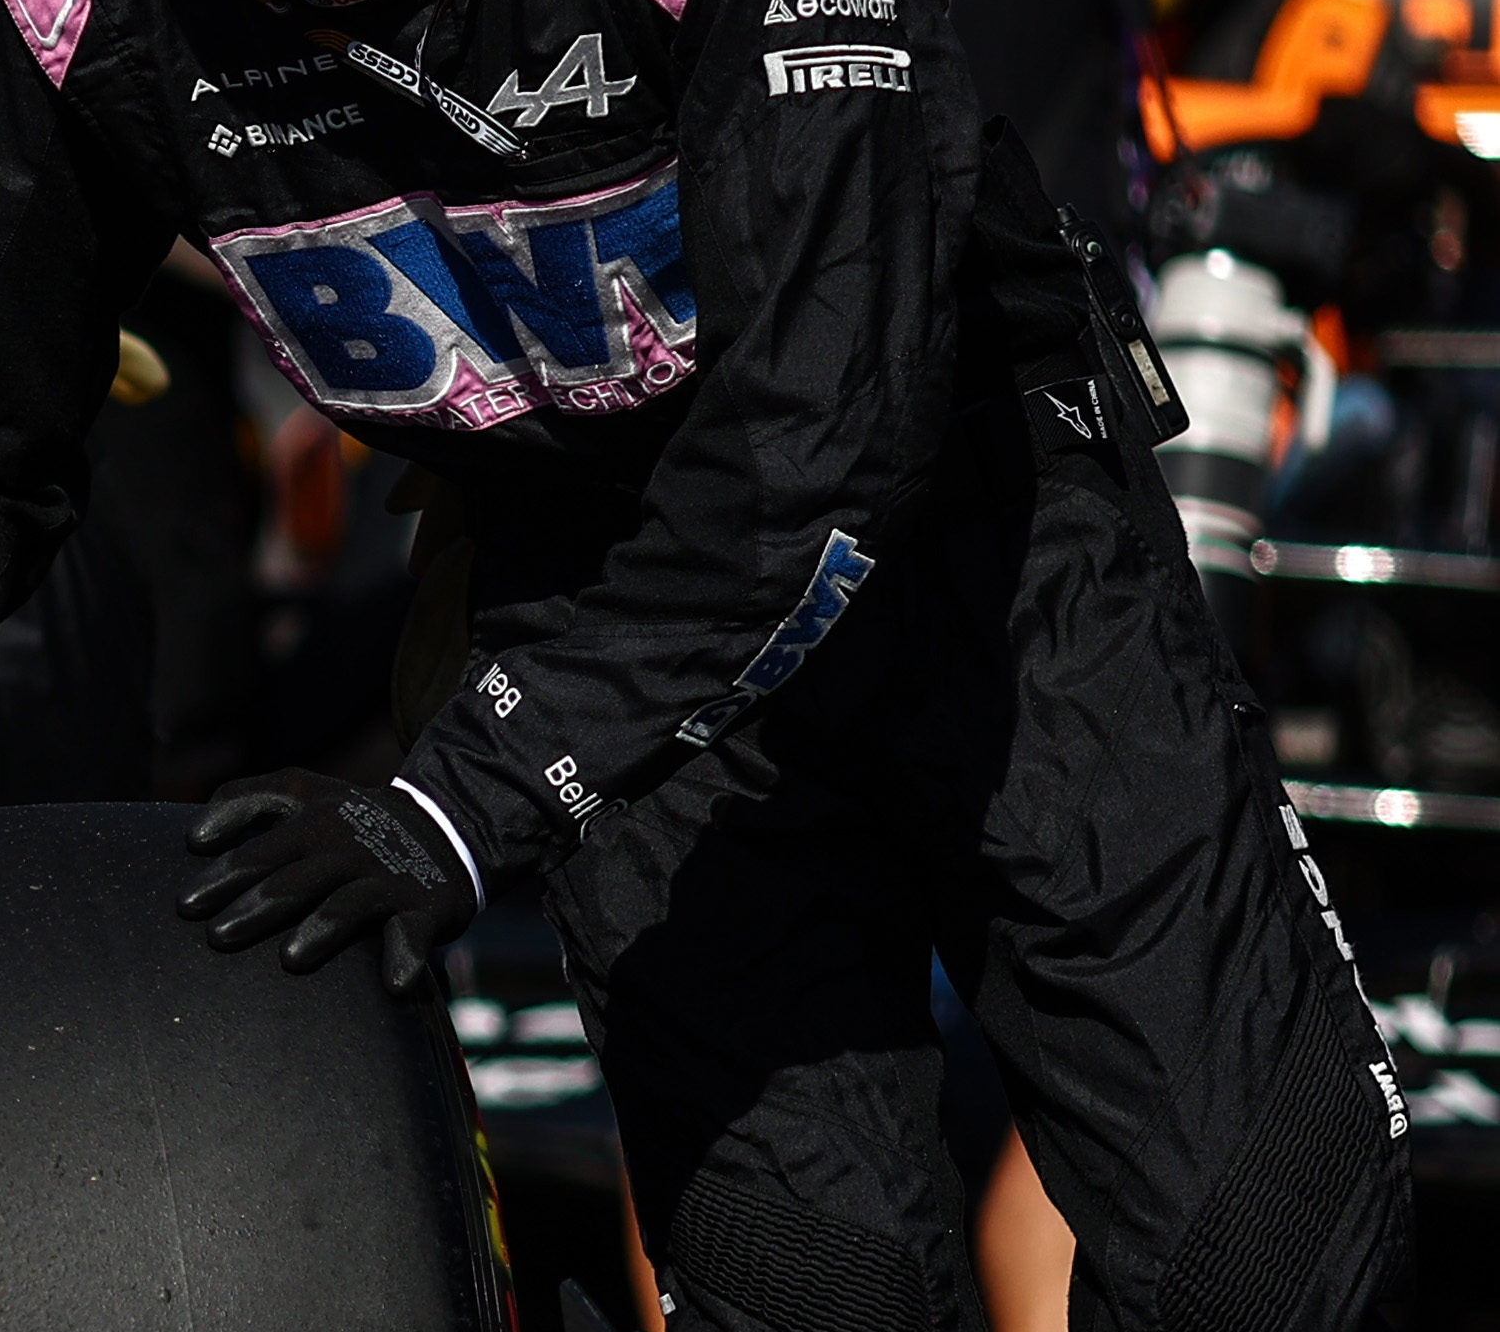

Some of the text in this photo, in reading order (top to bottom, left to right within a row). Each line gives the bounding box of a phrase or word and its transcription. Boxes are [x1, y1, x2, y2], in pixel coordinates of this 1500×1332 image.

[191, 52, 338, 102] ALPINE
[762, 44, 912, 97] PIRELLI
[244, 103, 366, 149] BINANCE
[232, 178, 698, 398] BWT
[732, 527, 878, 696] BWT
[476, 662, 523, 719] Bell
[543, 753, 604, 821] Bell
